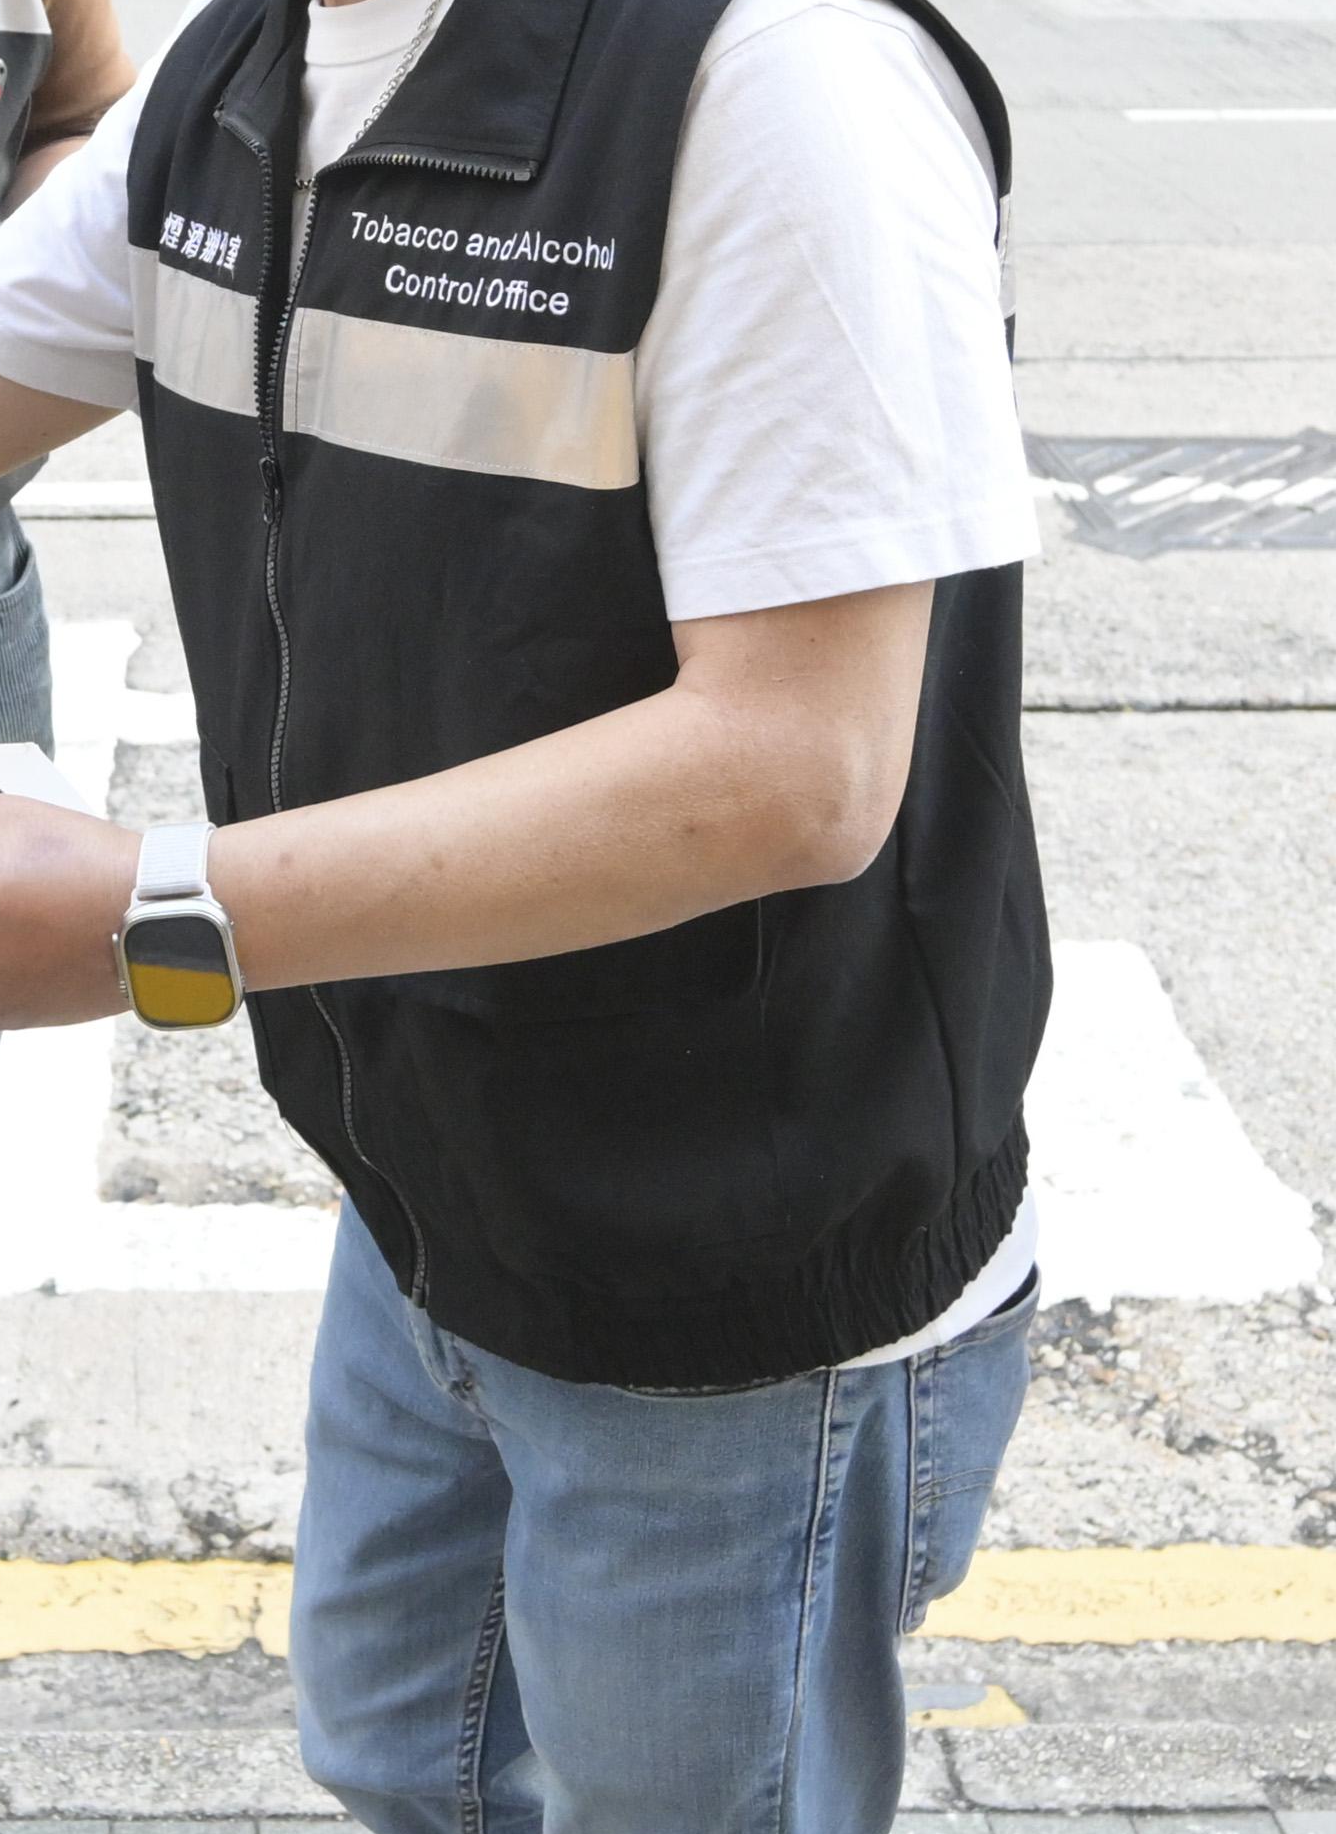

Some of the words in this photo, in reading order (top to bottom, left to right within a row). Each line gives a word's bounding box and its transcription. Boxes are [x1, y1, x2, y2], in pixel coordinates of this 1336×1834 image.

[351, 211, 460, 252] Tobacco
[514, 230, 616, 271] Alcohol
[384, 264, 485, 308] Control
[485, 277, 570, 315] Office
